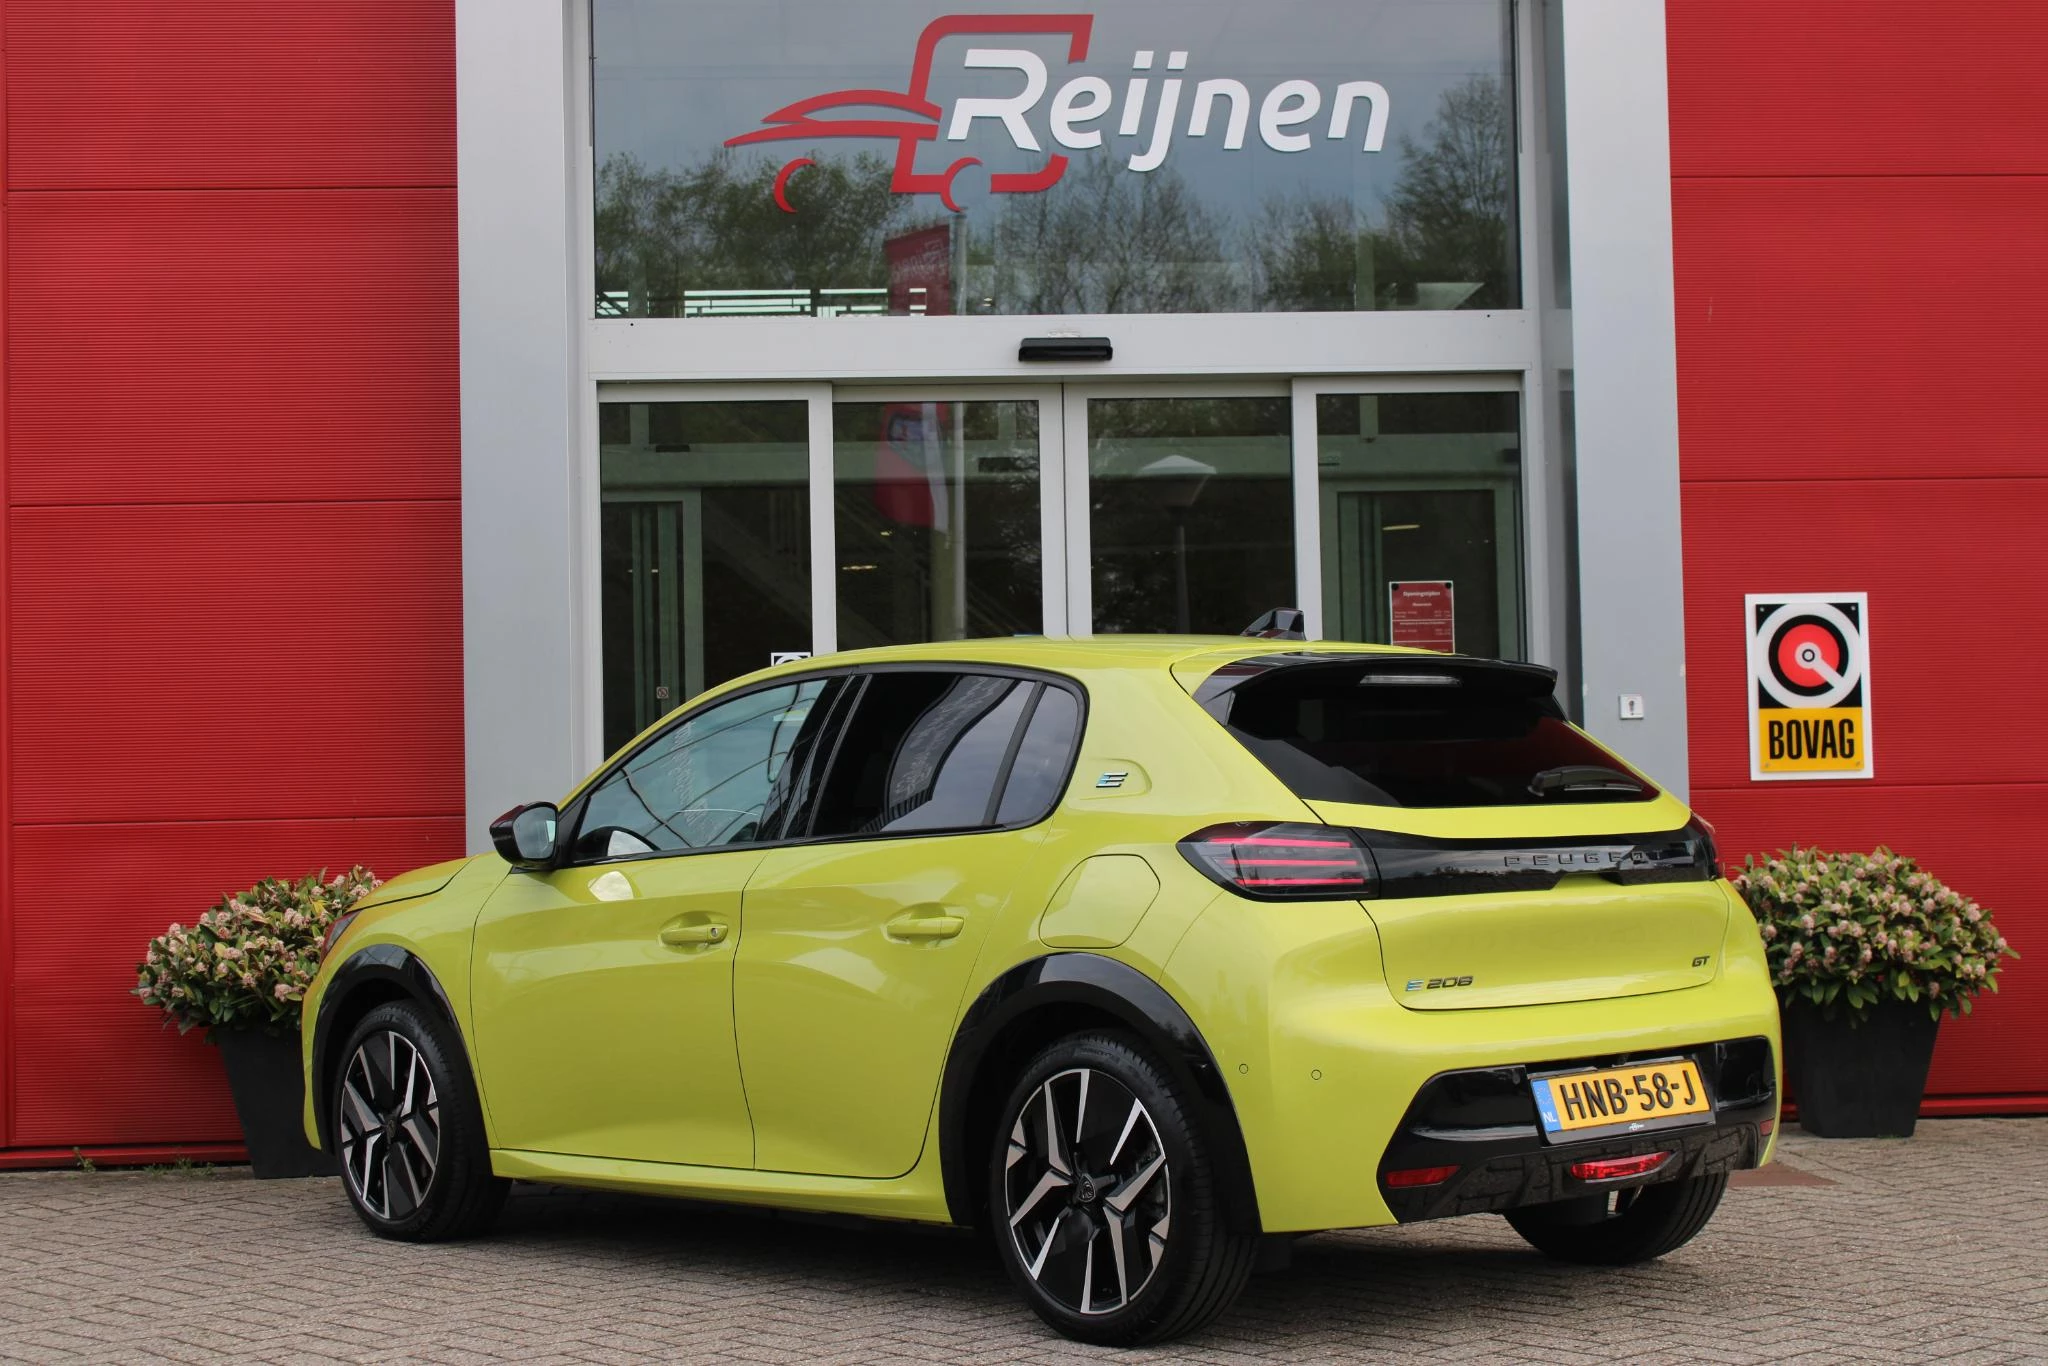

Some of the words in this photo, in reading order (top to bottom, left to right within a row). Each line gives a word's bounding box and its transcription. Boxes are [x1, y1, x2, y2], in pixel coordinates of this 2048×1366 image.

[947, 48, 1391, 173] Reijnen
[1768, 718, 1855, 760] BOVAG
[1692, 955, 1710, 967] GT
[1560, 1070, 1696, 1121] HNB-58-J
[1543, 1112, 1558, 1124] NL
